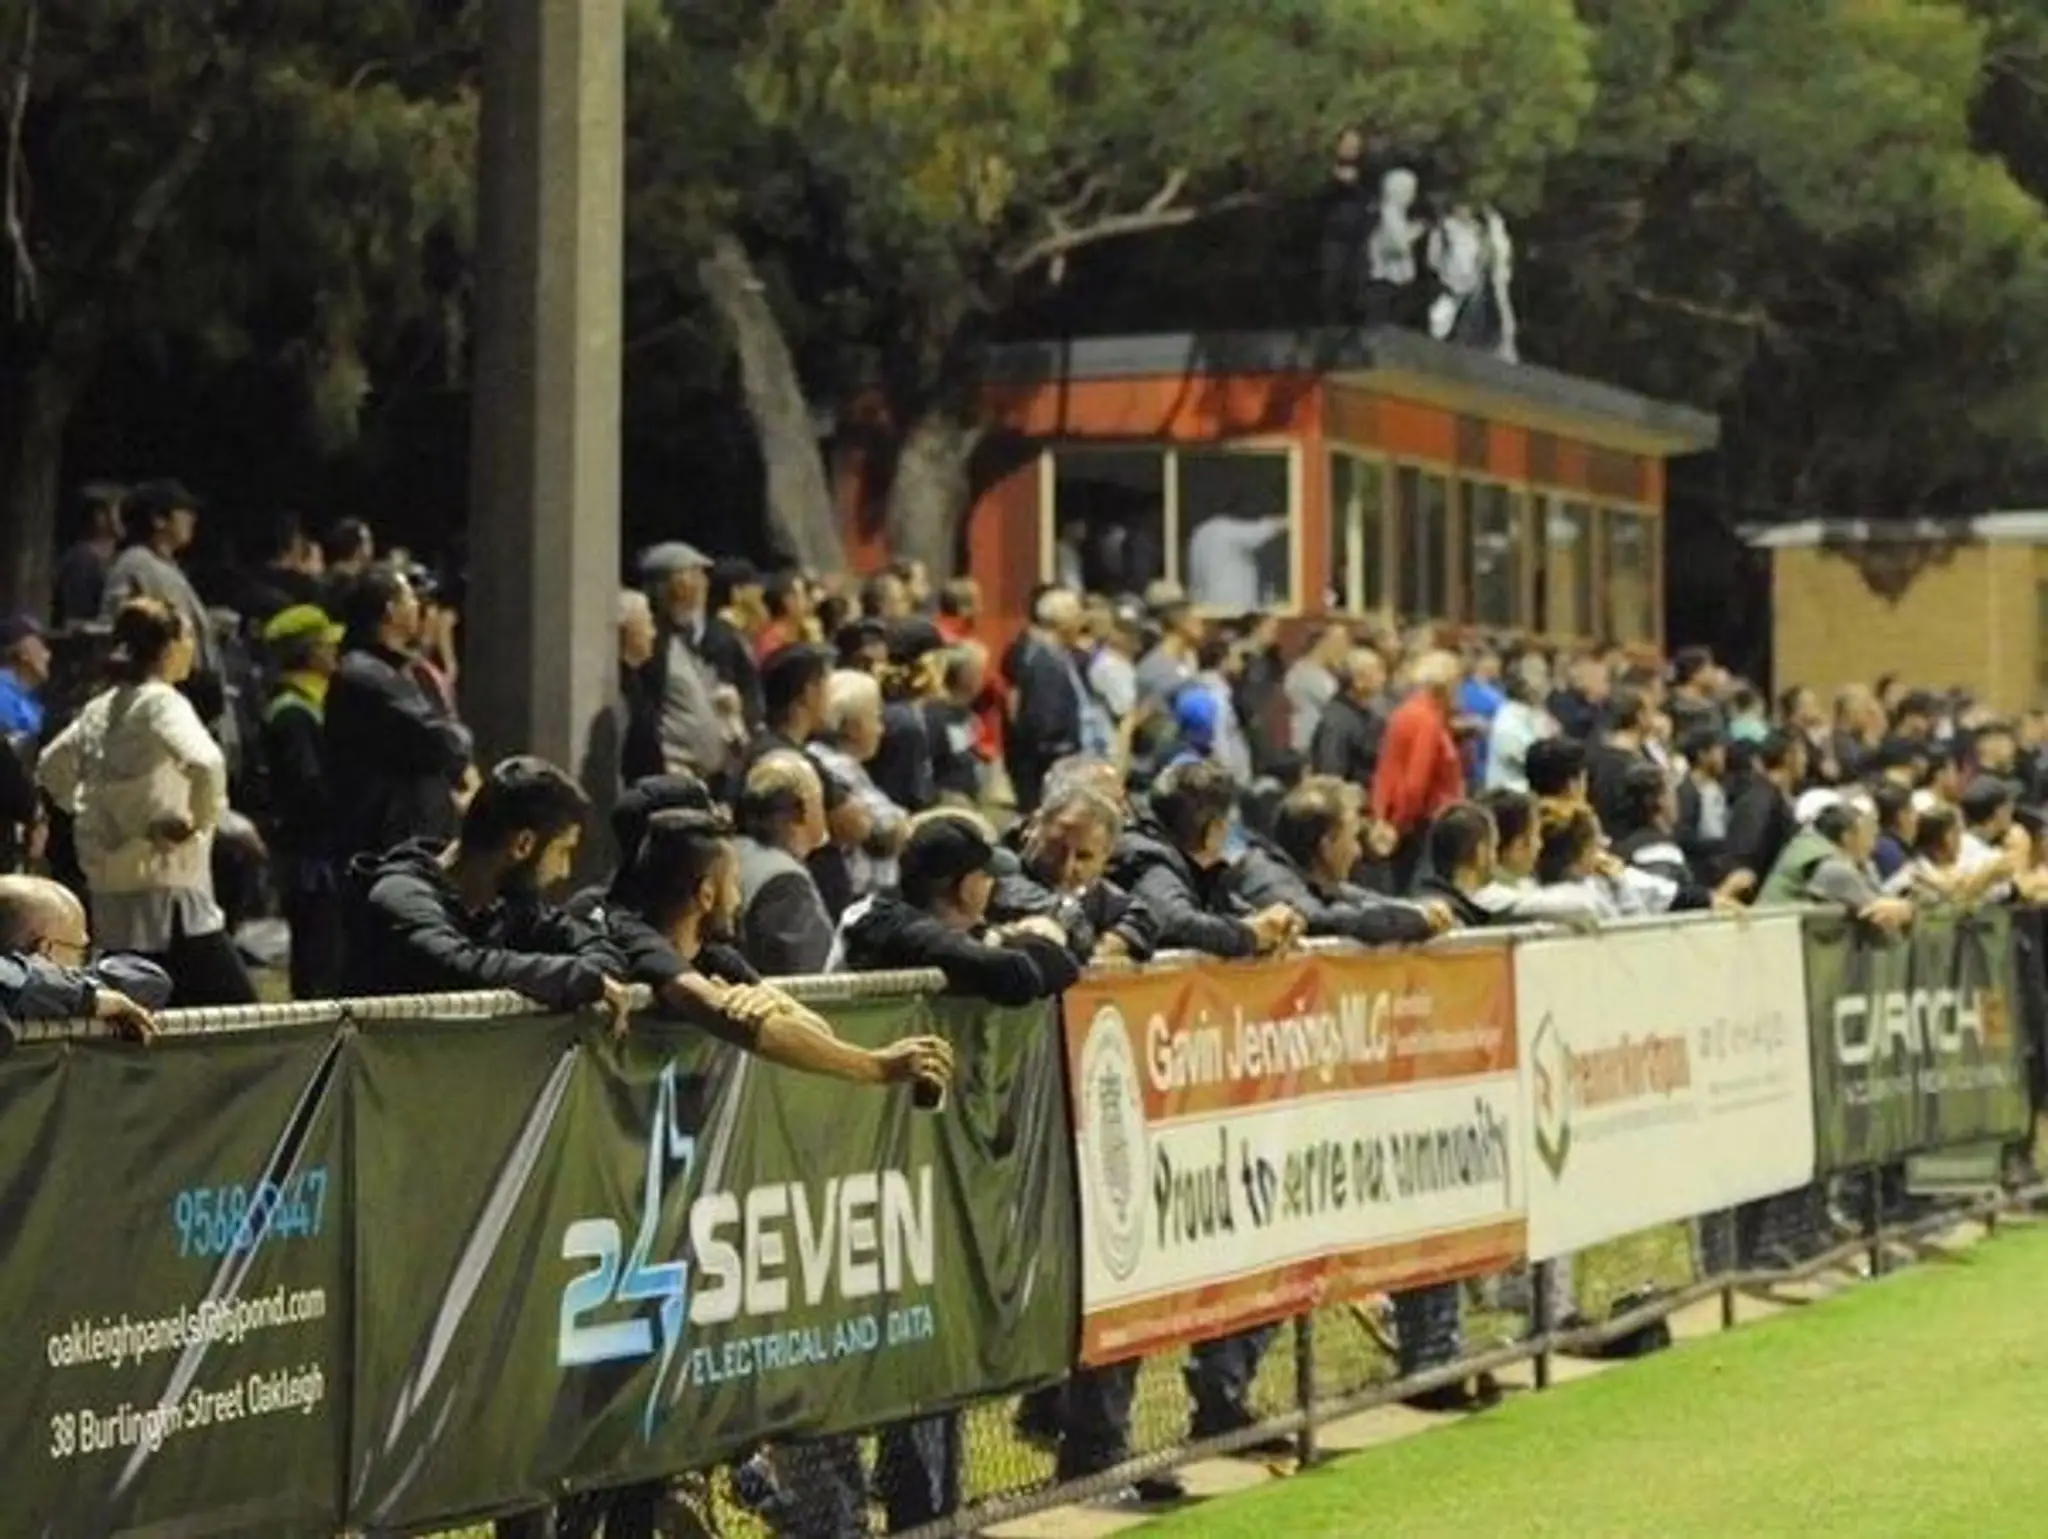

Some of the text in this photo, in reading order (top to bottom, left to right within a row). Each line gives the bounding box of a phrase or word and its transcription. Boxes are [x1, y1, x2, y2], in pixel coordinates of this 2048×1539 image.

[1153, 1124, 1235, 1250] Proud
[689, 1166, 935, 1325] SEVEN
[49, 1412, 76, 1459] 38
[248, 1358, 325, 1415] Oakleigh
[692, 1327, 827, 1385] ELECTRICAL
